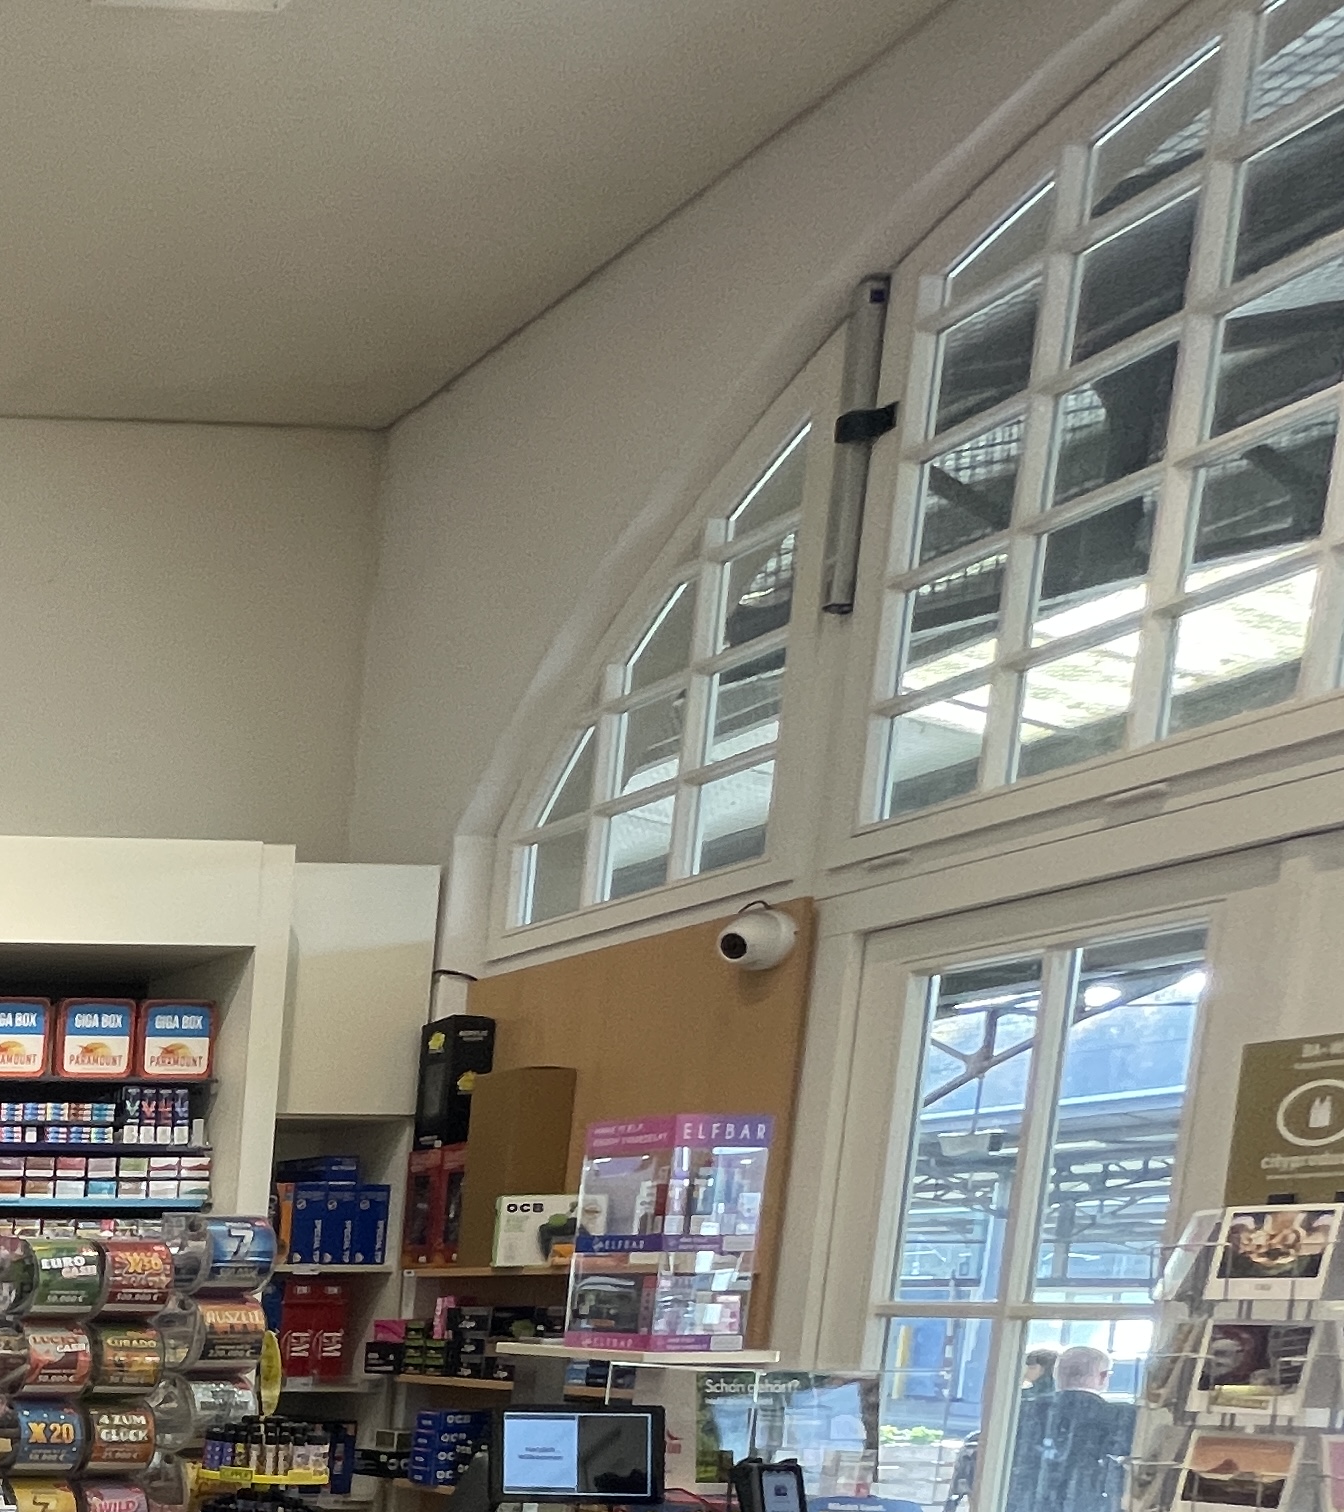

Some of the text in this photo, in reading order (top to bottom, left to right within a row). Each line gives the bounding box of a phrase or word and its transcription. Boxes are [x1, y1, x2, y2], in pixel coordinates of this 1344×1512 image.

[16, 1012, 37, 1027] BOX
[75, 1013, 122, 1028] GIGA BOX
[155, 1015, 203, 1030] GIGA BOX
[69, 1054, 122, 1066] PARAMOUNT
[150, 1055, 203, 1067] PARAMOUNT
[683, 1122, 766, 1140] ELFBAR
[507, 1203, 544, 1213] OCB
[228, 1228, 254, 1256] 7
[41, 1256, 85, 1269] EURO
[206, 1309, 264, 1324] AUSZEIT
[705, 1379, 747, 1394] Schön
[113, 1415, 146, 1425] ZUM
